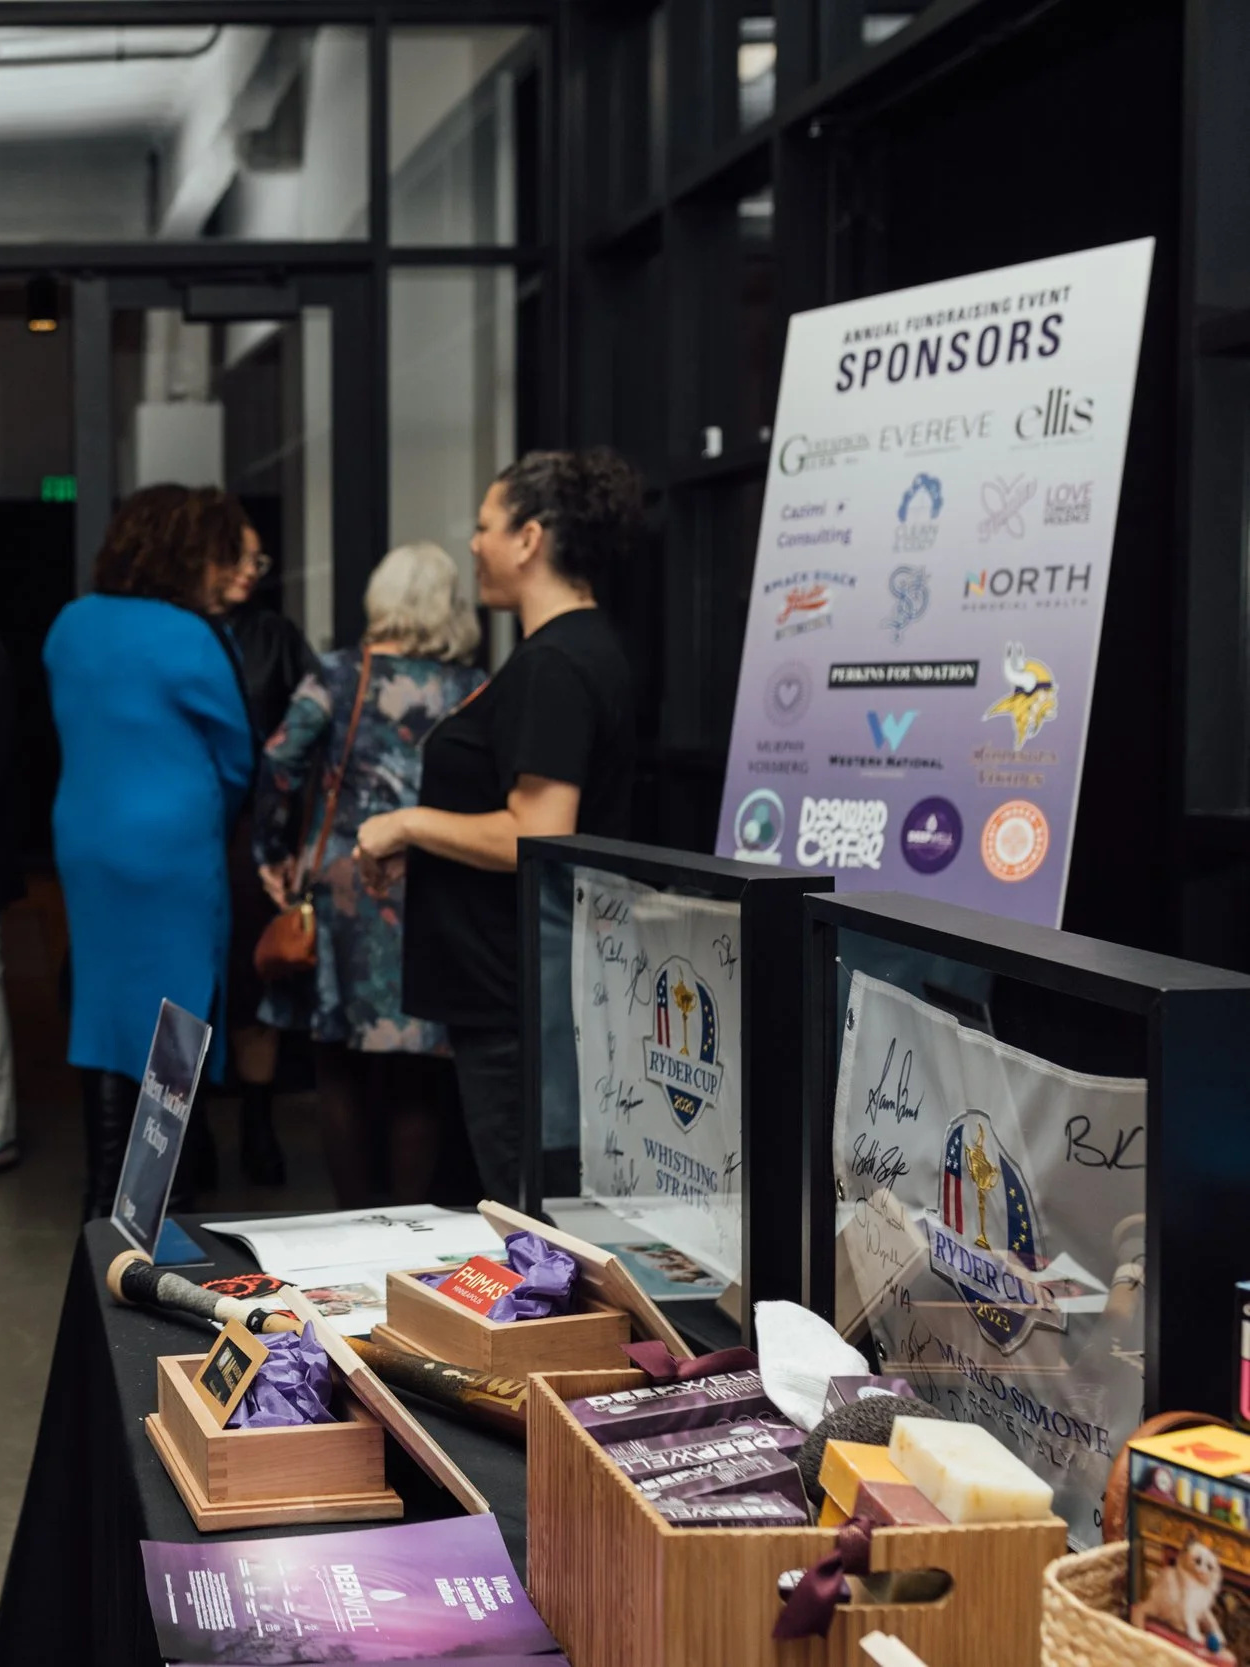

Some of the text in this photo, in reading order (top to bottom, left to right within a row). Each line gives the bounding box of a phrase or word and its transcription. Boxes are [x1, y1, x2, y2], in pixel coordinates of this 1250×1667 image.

[844, 284, 1071, 345] ANNUAL FUNDRAISING EVENT
[835, 312, 1063, 393] SPONSORS
[878, 410, 994, 451] EVEREVE
[1015, 386, 1093, 441] ellis
[1046, 480, 1094, 506] LOVE
[776, 528, 852, 549] Consulting
[963, 562, 1092, 598] NORTH
[831, 663, 975, 683] PERKINS FOUNDATION
[886, 755, 944, 771] NATIONAL
[649, 1051, 718, 1095] RYDER CUP
[643, 1136, 717, 1193] WHISTLING
[656, 1168, 711, 1214] STRAITS
[453, 1265, 510, 1300] FHIMA'S
[933, 1230, 1000, 1294] RYDER
[1002, 1271, 1055, 1314] CUP
[452, 1285, 485, 1305] MINNEAPOLIS
[975, 1298, 1011, 1332] 2023
[935, 1336, 1007, 1402] MARCO
[1010, 1386, 1112, 1458] SIMONE
[618, 1432, 779, 1473] DEEPWELL
[330, 1564, 375, 1632] DEEPWELL
[434, 1578, 458, 1607] nature
[453, 1577, 487, 1620] is one with
[471, 1576, 499, 1611] science
[490, 1575, 514, 1604] Where
